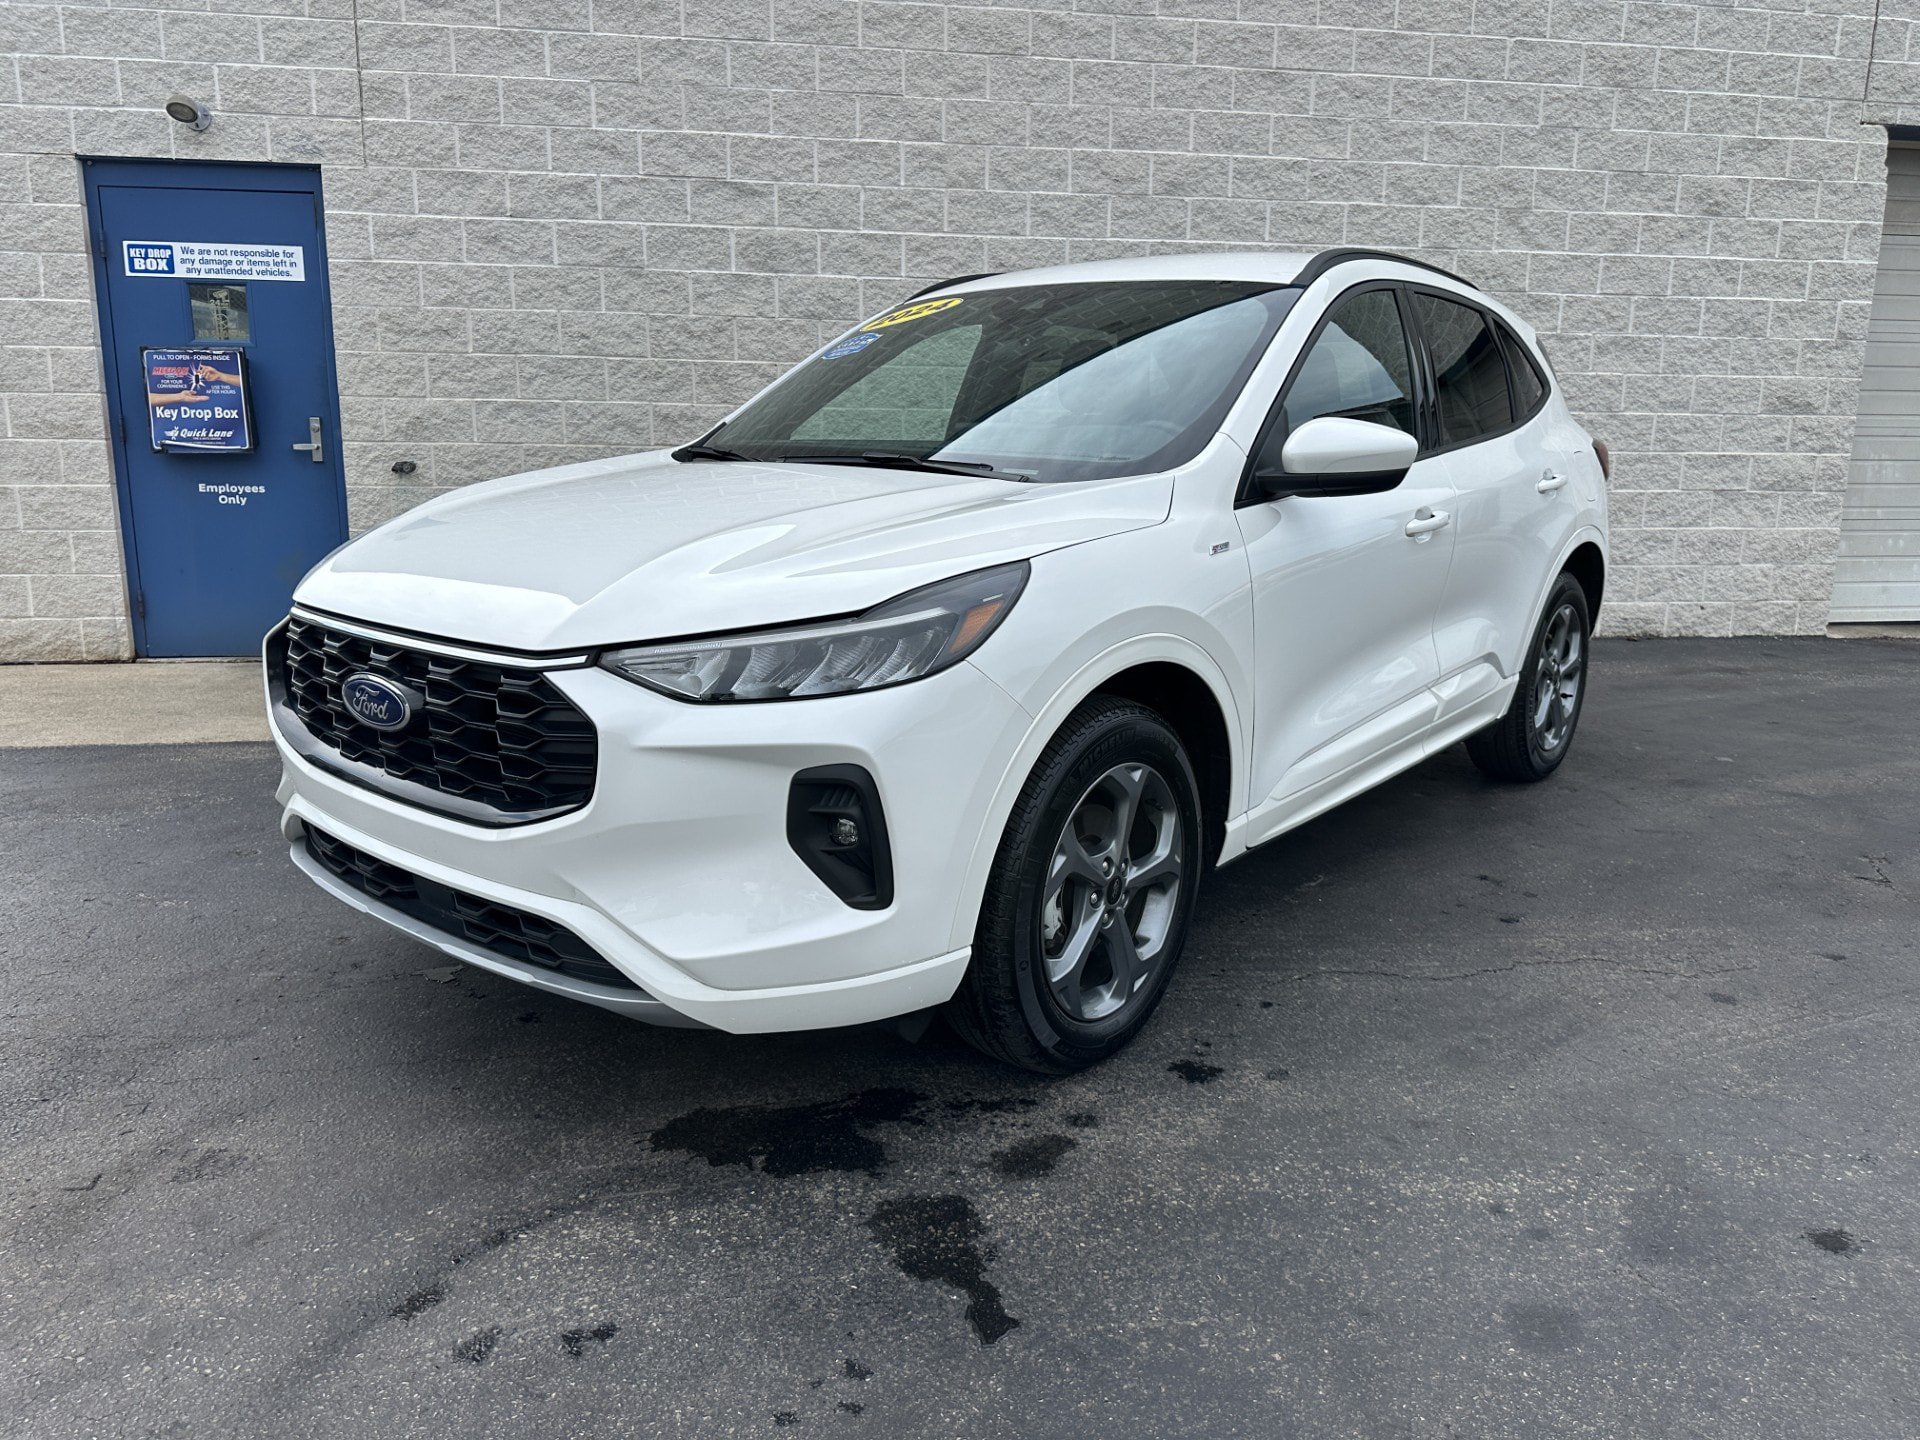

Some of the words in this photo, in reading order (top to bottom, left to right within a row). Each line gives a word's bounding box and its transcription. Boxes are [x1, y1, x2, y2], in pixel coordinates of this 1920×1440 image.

[129, 247, 146, 258] KEY
[147, 248, 172, 259] DROP
[180, 246, 195, 256] We
[197, 248, 212, 256] are
[213, 248, 228, 256] not
[230, 248, 280, 260] responsible
[282, 250, 295, 258] for
[133, 258, 169, 271] BOX
[180, 258, 196, 267] any
[198, 257, 233, 267] damage
[246, 258, 271, 267] items
[272, 259, 288, 267] left
[289, 260, 297, 268] in
[185, 267, 202, 276] any
[204, 267, 253, 276] unattended
[255, 268, 293, 277] vehicles.
[156, 406, 178, 421] Key
[181, 406, 212, 421] Drop
[214, 407, 239, 419] Box
[180, 427, 206, 438] Quick
[208, 428, 233, 438] Lane
[198, 484, 266, 494] Employees
[218, 496, 247, 506] Only
[353, 685, 389, 720] Ford
[1078, 726, 1137, 776] MICHELIN
